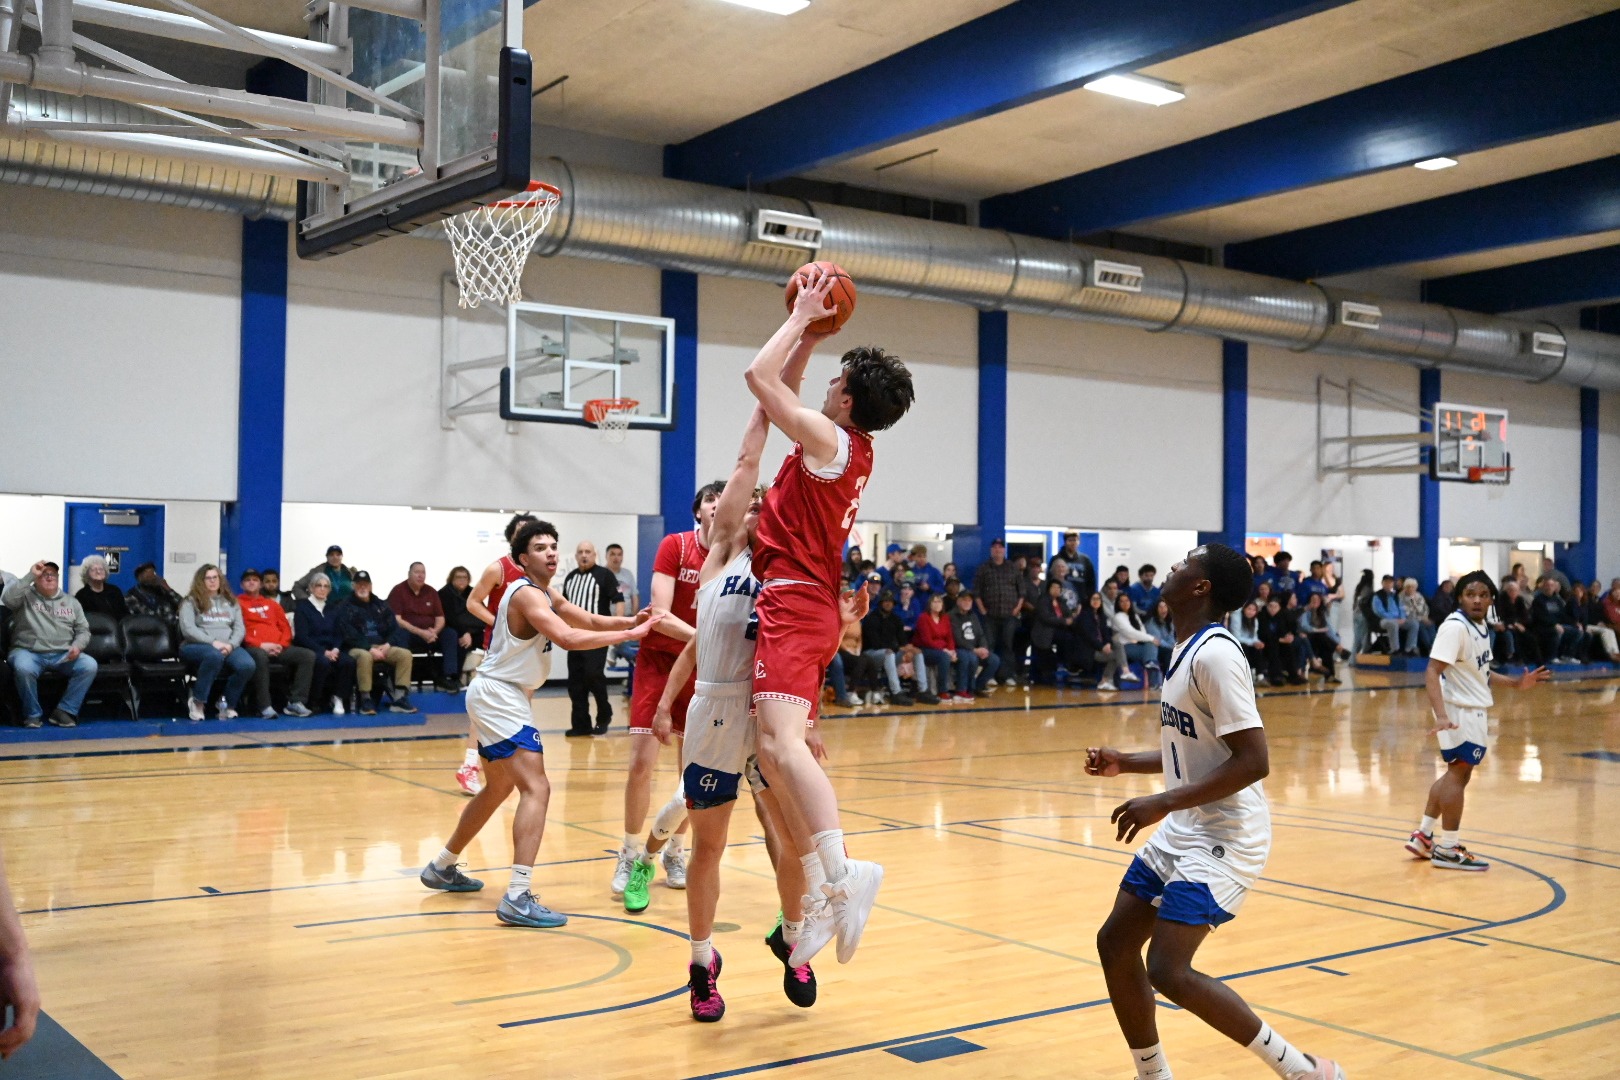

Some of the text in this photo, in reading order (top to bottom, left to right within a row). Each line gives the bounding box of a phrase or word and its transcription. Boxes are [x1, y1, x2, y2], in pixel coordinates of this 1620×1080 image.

[678, 568, 700, 584] RED
[1171, 741, 1181, 779] 1
[699, 773, 718, 792] GH
